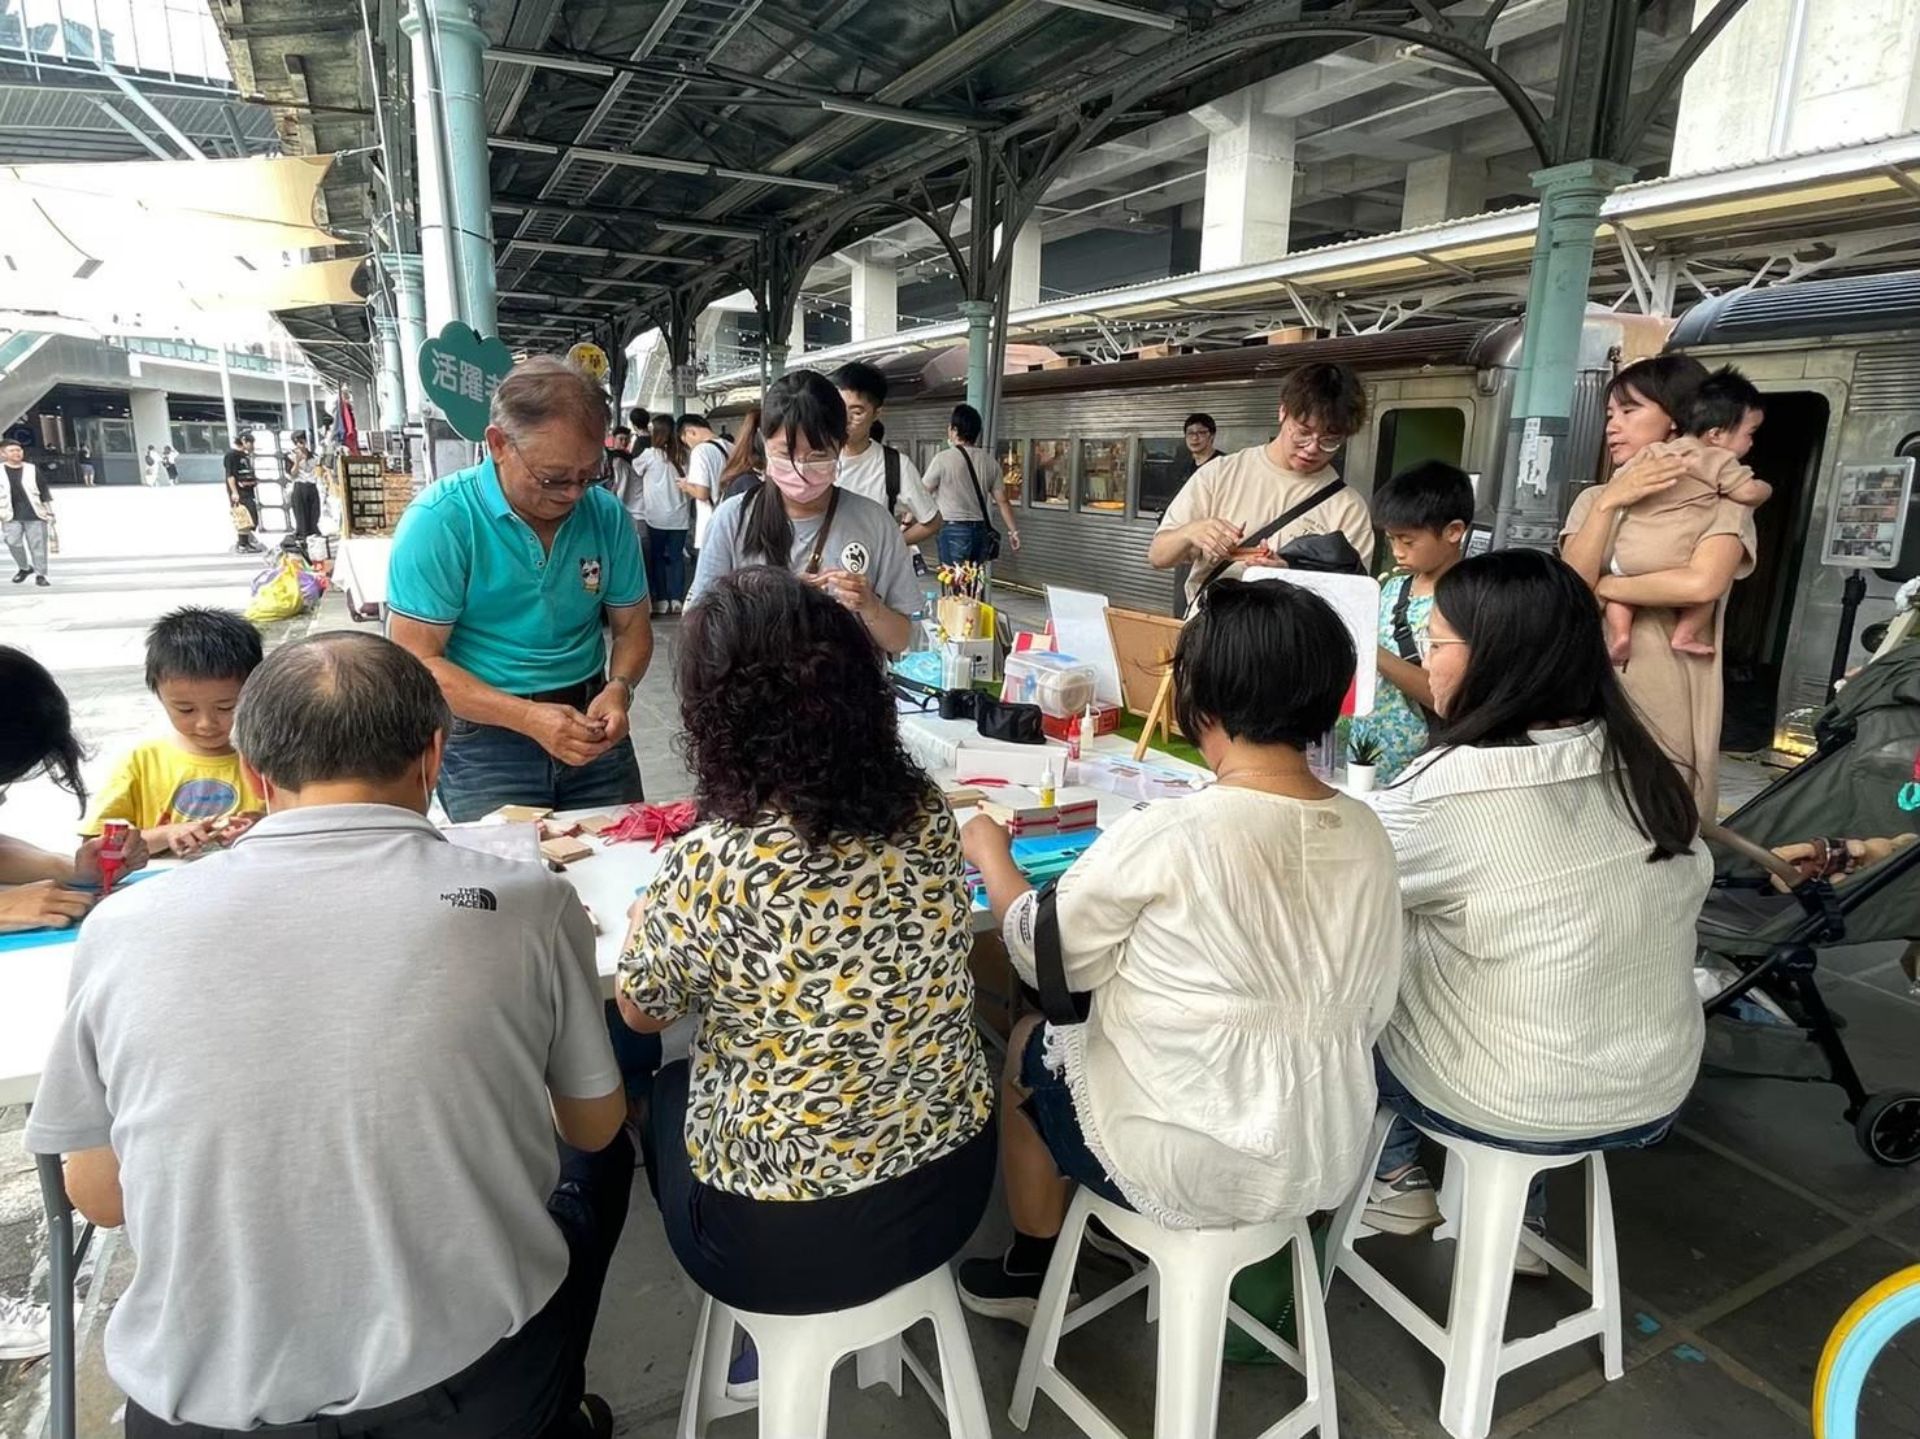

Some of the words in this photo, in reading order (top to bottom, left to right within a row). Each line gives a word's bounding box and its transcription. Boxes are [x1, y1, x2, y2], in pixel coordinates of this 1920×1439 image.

[457, 887, 479, 895] THE
[440, 893, 479, 901] NORTH
[452, 900, 479, 909] FACE
